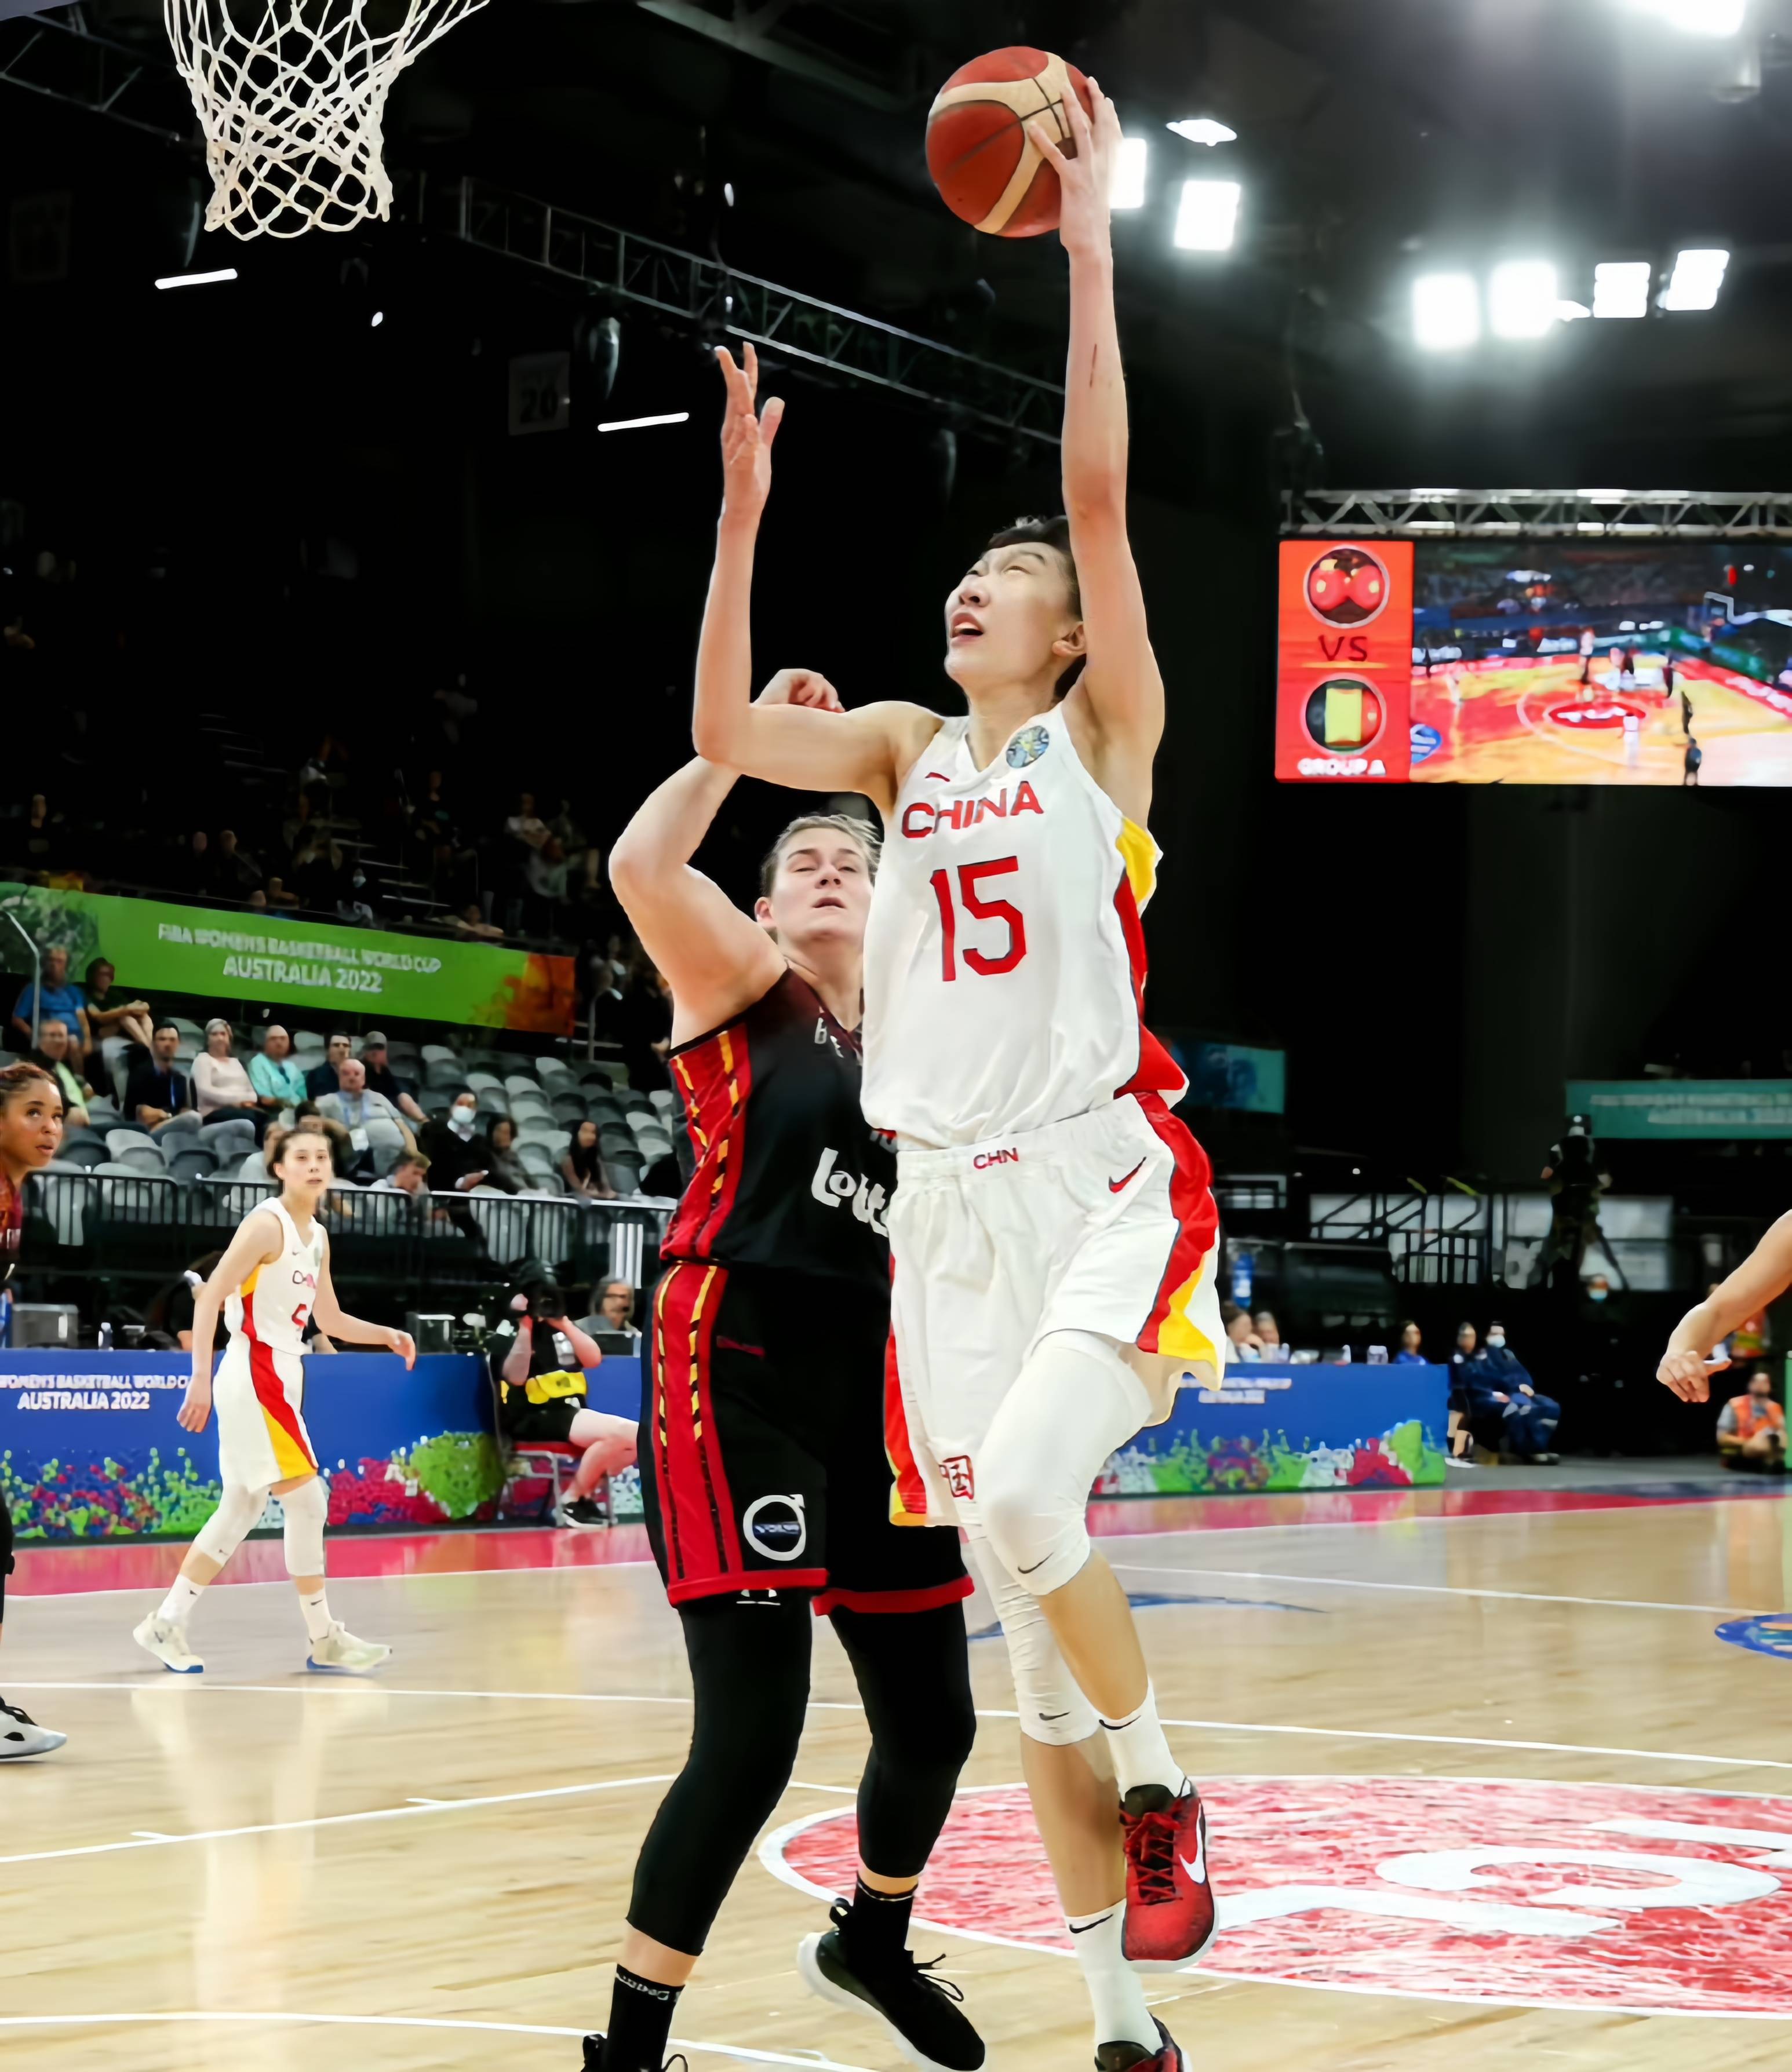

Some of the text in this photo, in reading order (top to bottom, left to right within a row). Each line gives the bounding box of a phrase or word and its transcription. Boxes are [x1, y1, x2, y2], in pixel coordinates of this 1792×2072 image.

[1318, 635, 1368, 662] VS
[1367, 759, 1386, 776] A
[902, 780, 1044, 838] CHINA
[930, 856, 1026, 982] 15
[361, 949, 413, 971] WORLD
[414, 957, 442, 973] CUP
[223, 955, 383, 993] AUSTRALIA 2022
[973, 1148, 1019, 1170] CHN
[132, 1374, 177, 1389] WORLD
[17, 1391, 150, 1410] AUSTRALIA 2022
